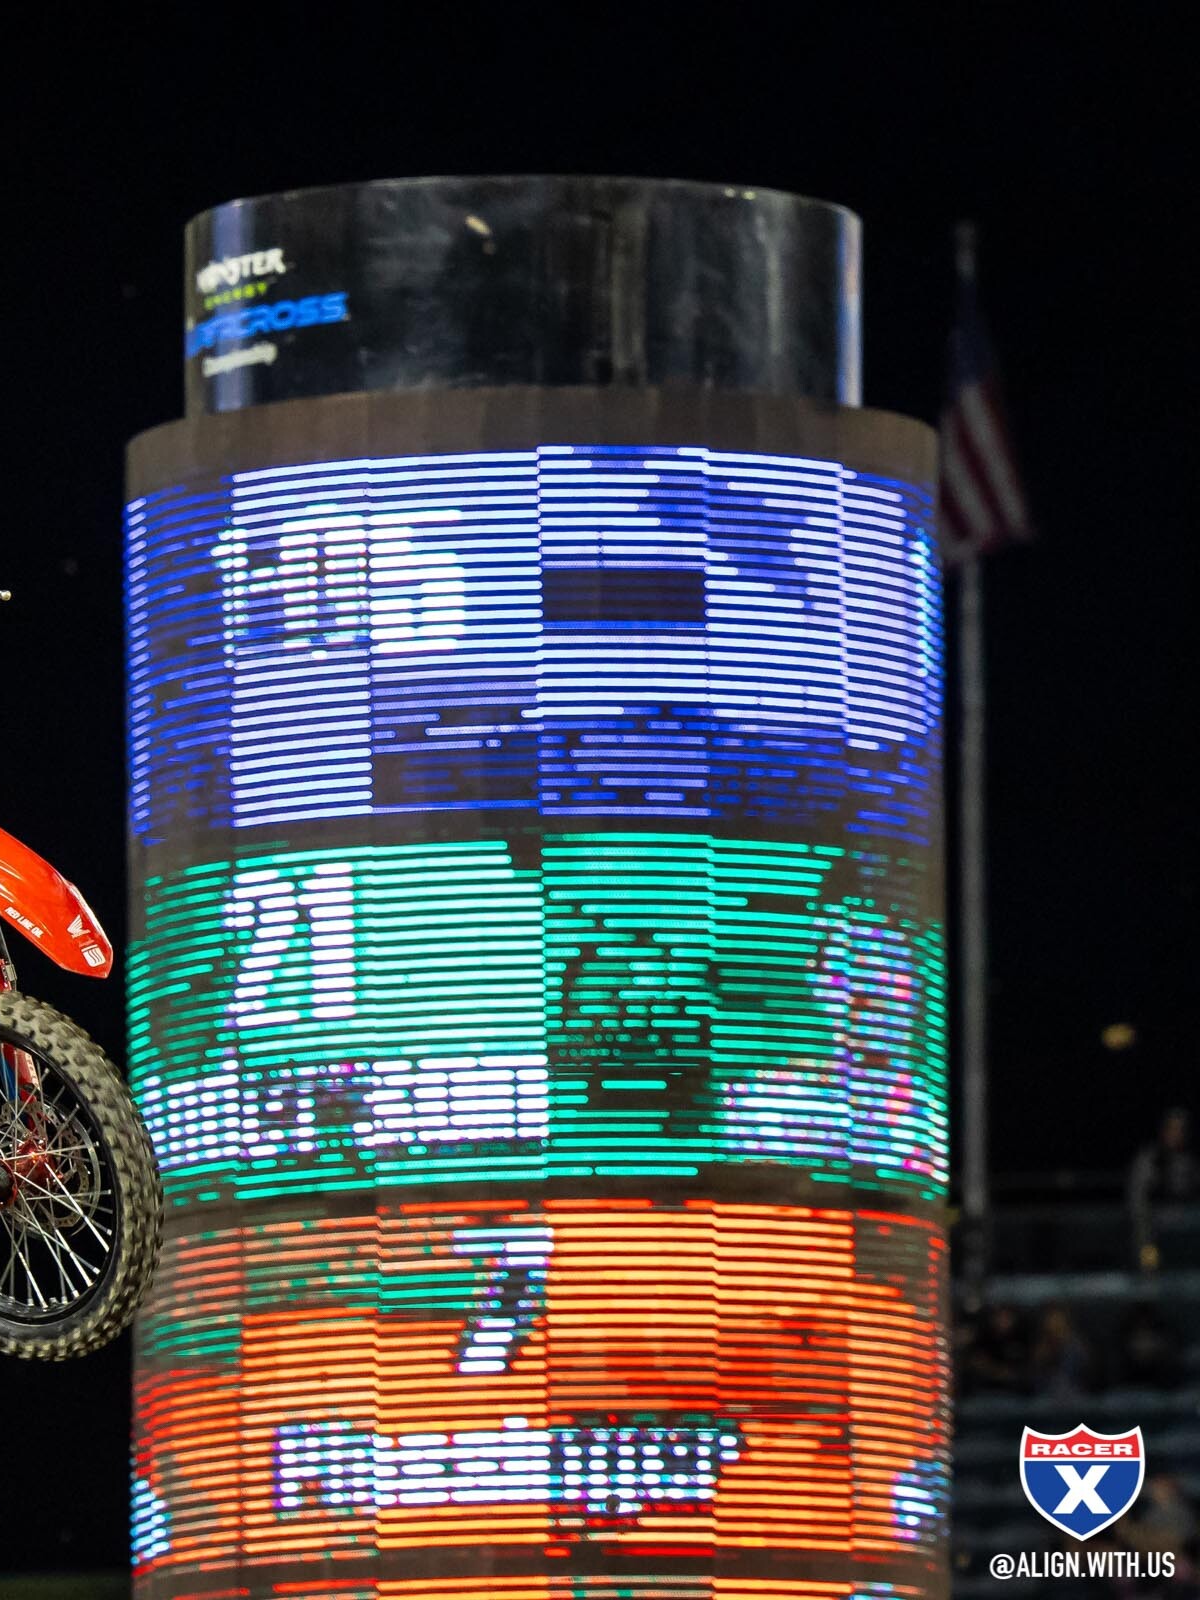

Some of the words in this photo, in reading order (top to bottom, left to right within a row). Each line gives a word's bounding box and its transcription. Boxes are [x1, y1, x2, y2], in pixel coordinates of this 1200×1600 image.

[5, 906, 20, 919] RED
[16, 916, 35, 931] LINE
[31, 927, 44, 938] OIL
